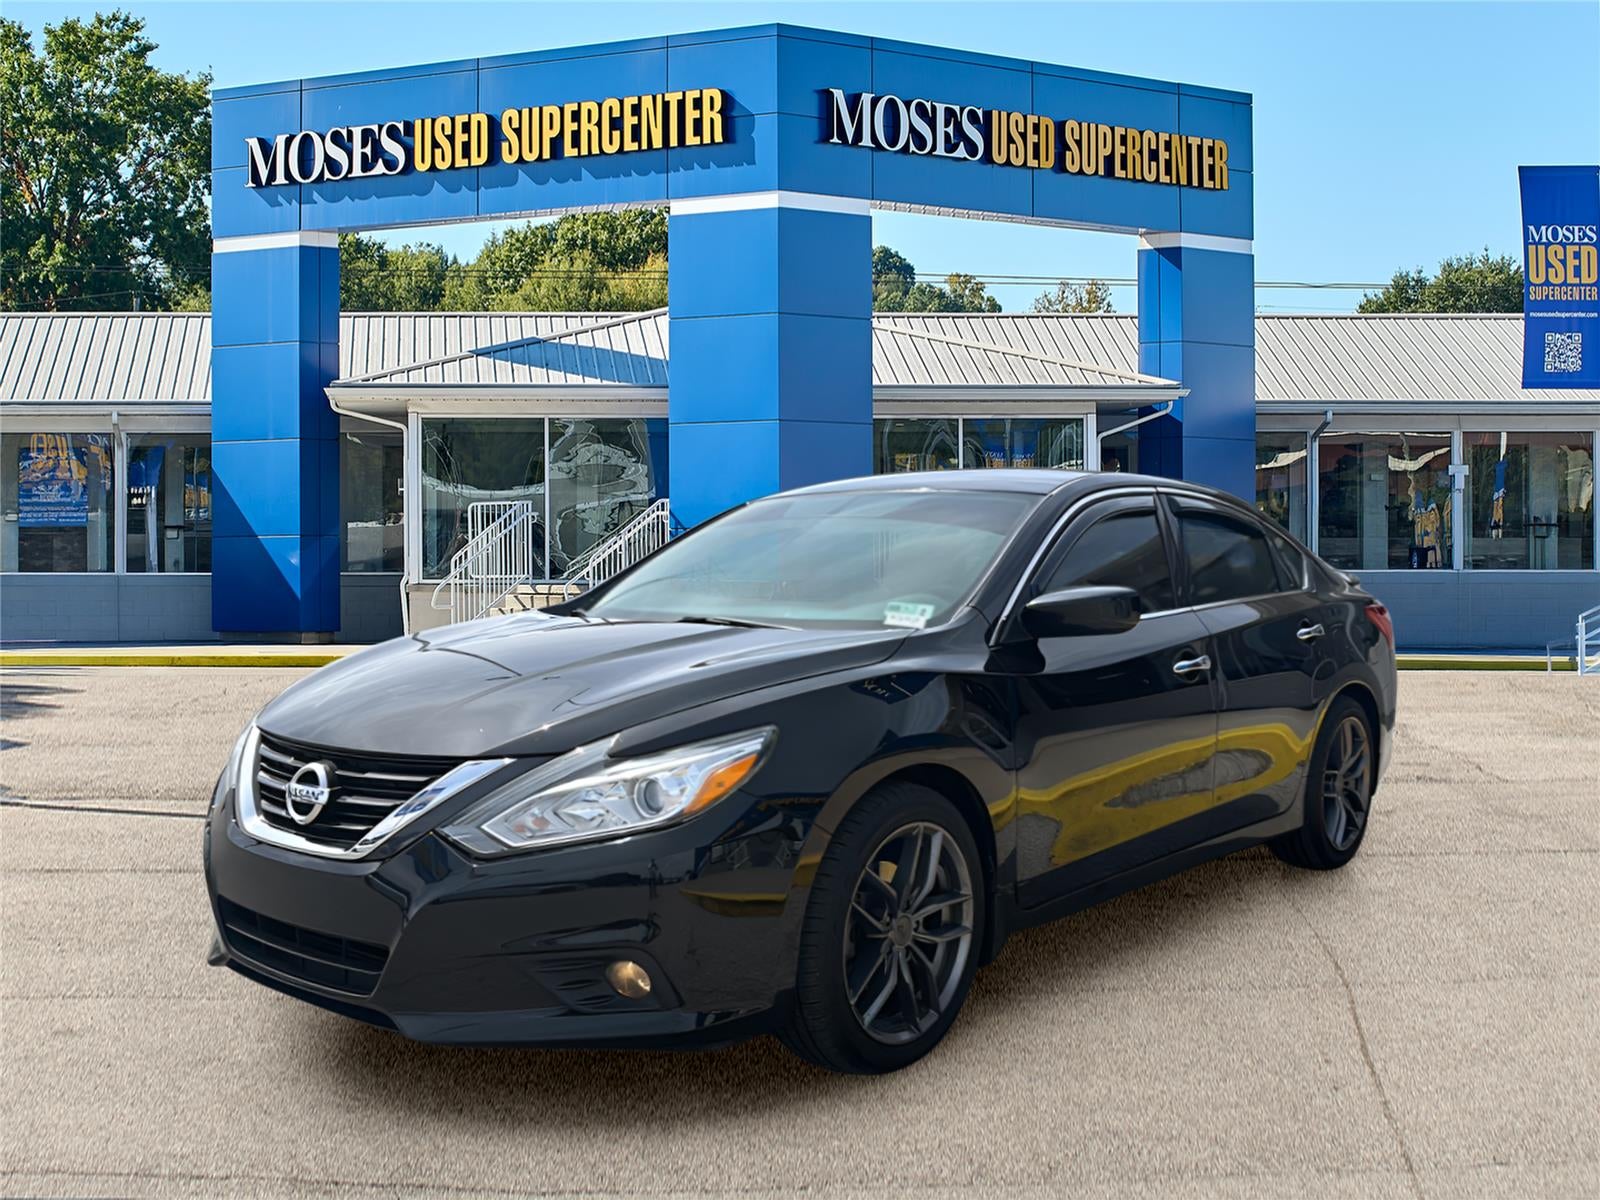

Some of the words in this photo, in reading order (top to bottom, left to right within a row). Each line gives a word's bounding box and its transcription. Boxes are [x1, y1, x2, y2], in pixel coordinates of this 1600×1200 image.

[244, 120, 407, 188] MOSES
[413, 112, 489, 172] USED
[501, 87, 724, 165] SUPERCENTER
[829, 87, 985, 162] MOSES
[991, 109, 1056, 169] USED
[1064, 119, 1230, 190] SUPERCENTER
[1527, 224, 1597, 244] MOSES
[1527, 244, 1598, 285] USED
[1529, 285, 1598, 301] SUPERCENTER
[1529, 310, 1598, 319] mosesusedsupercenter.com
